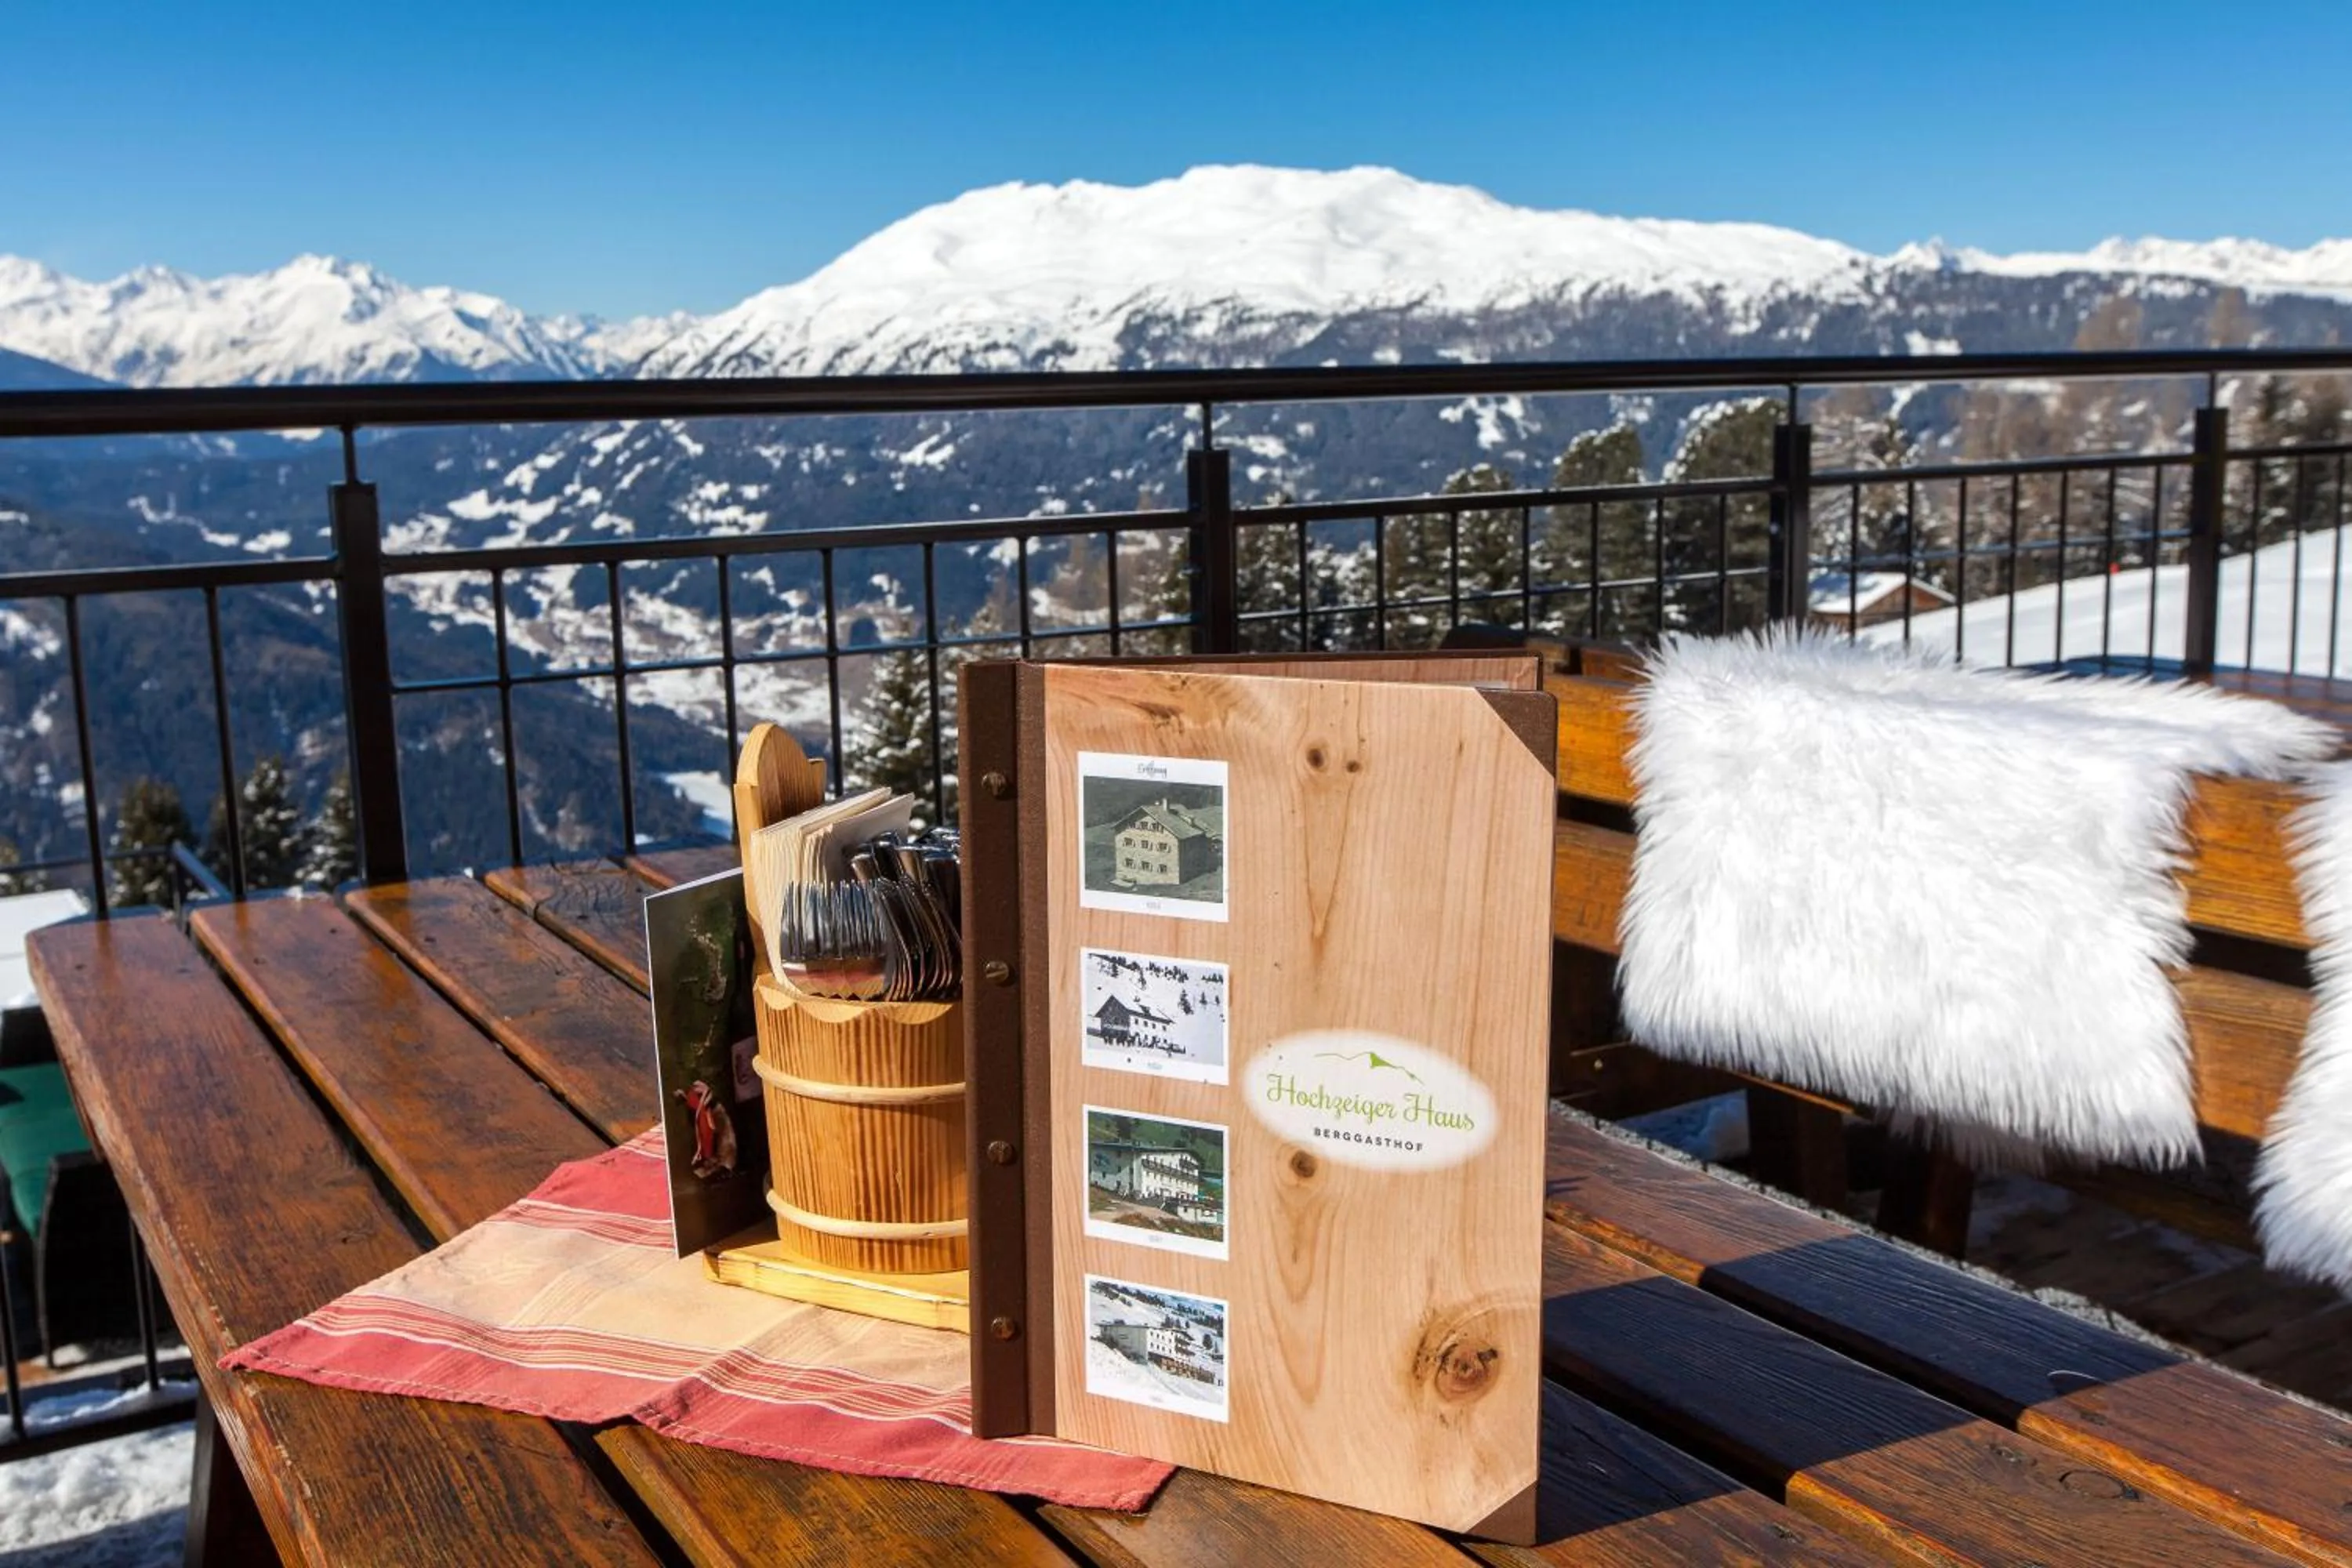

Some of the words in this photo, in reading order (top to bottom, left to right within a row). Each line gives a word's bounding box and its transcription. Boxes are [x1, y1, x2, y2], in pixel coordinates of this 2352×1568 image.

[1266, 1073, 1397, 1124] Hochzeiger
[1403, 1093, 1475, 1131] Haus
[1313, 1127, 1424, 1152] BERGGASTHOF
